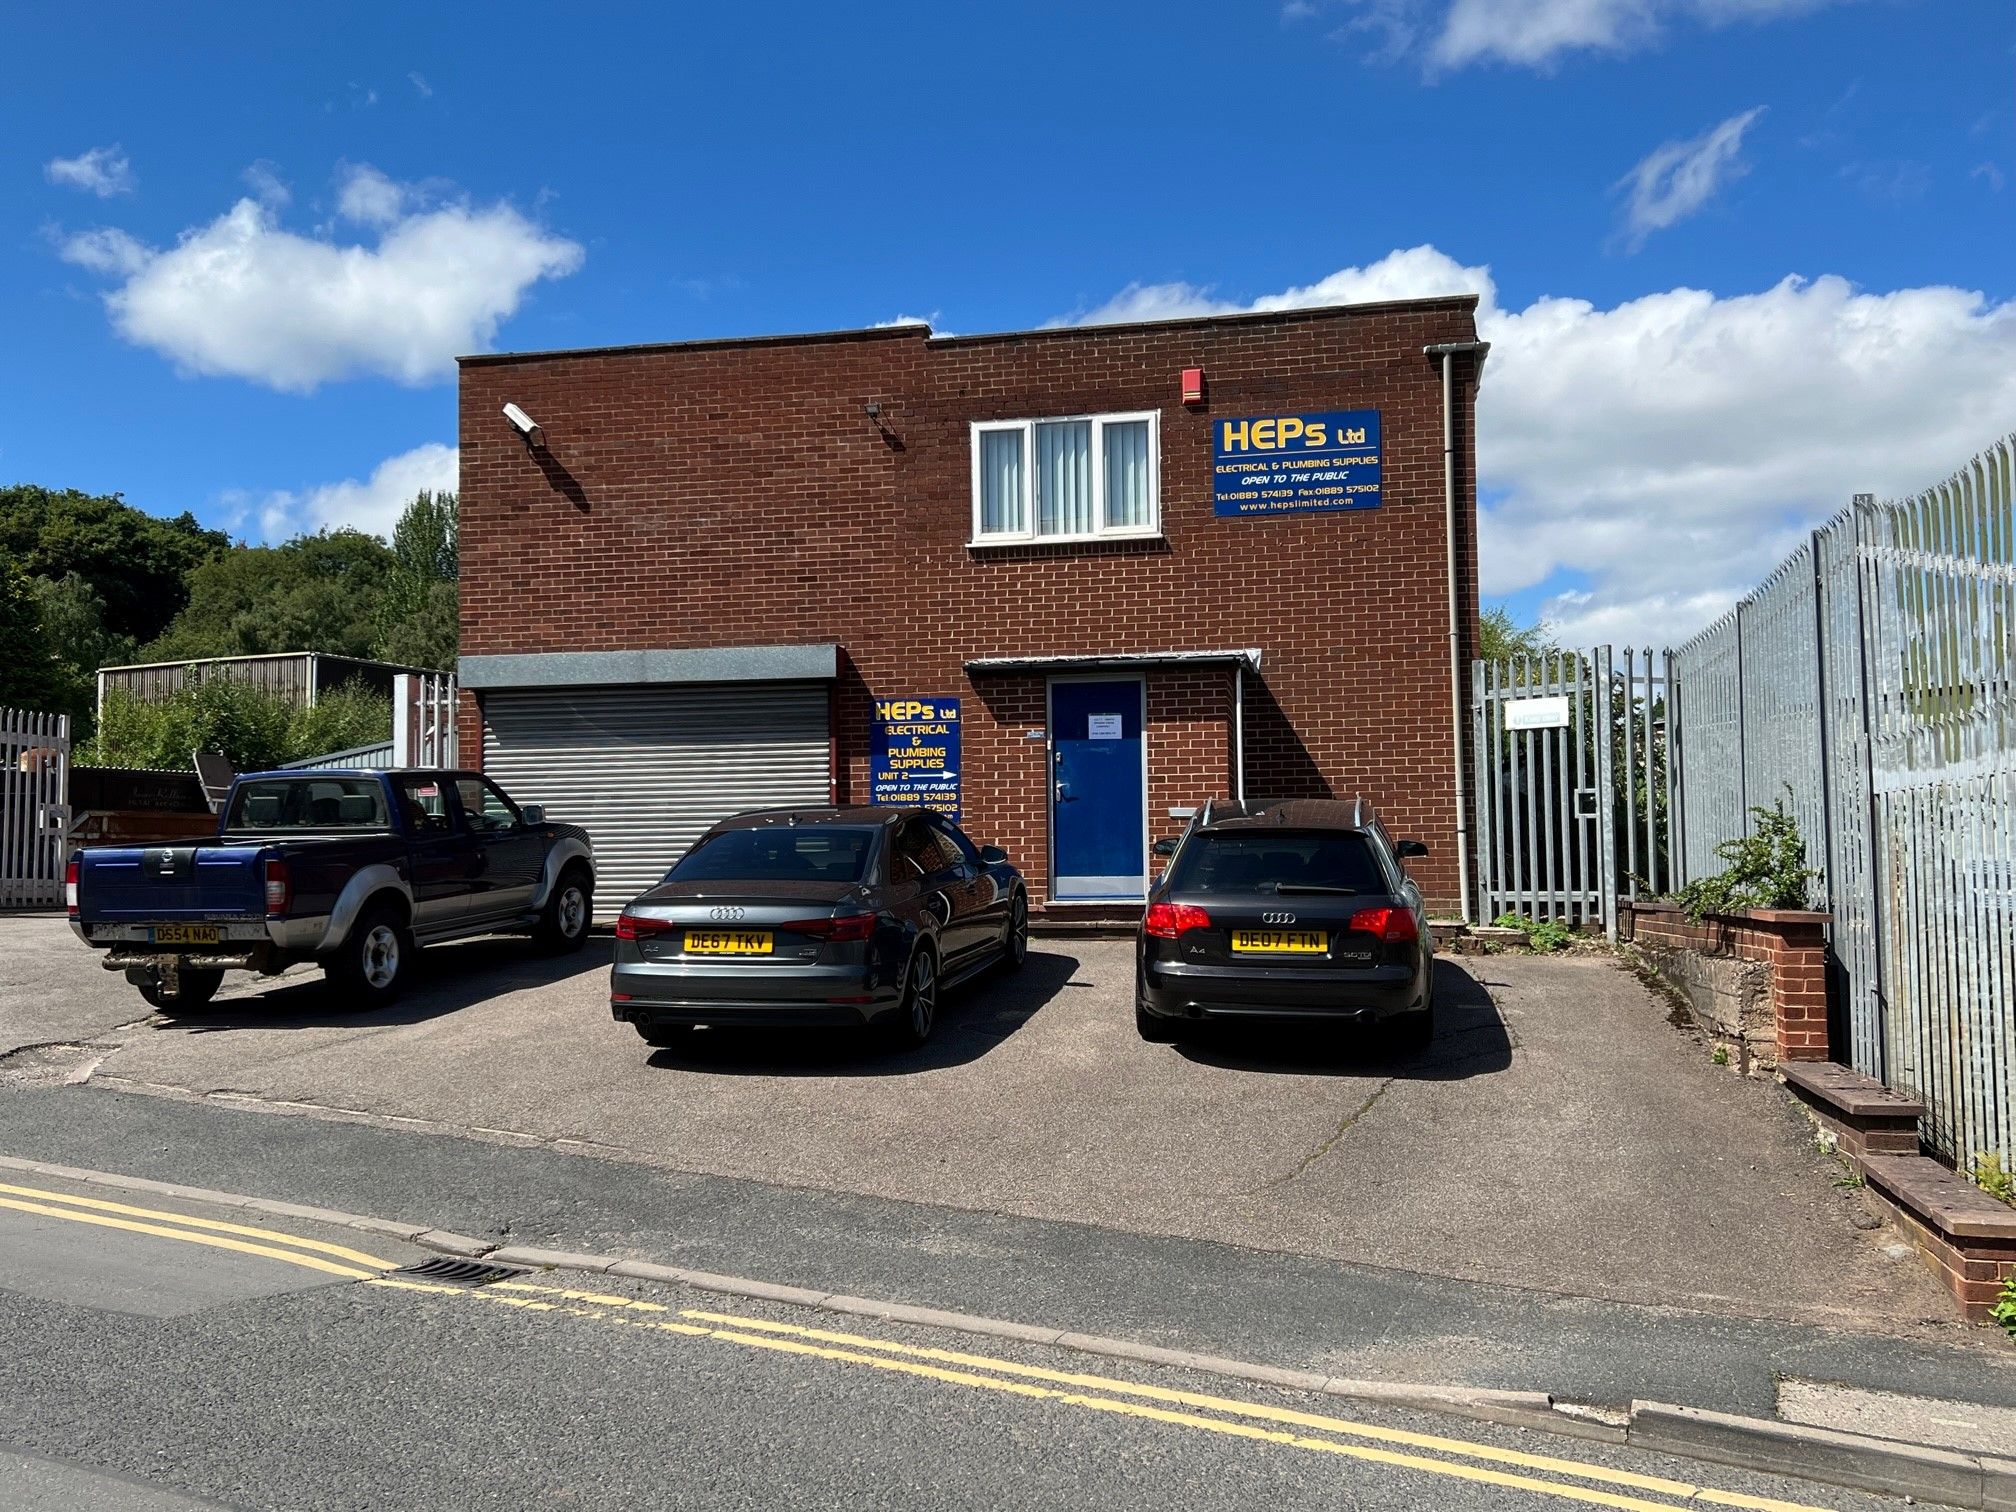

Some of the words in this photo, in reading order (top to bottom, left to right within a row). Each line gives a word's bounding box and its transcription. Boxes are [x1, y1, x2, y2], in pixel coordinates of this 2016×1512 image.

[1223, 417, 1327, 452] HEPs
[1337, 427, 1366, 445] Ltd
[1215, 462, 1269, 474] ELECTRICAL
[1271, 461, 1279, 470] &
[1282, 458, 1330, 470] PLUMBING
[1332, 455, 1379, 466] SUPPLIES
[1241, 475, 1270, 486] OPEN
[1273, 474, 1287, 484] TO
[1290, 473, 1310, 483] THE
[1312, 470, 1350, 482] PUBLIC
[1261, 489, 1294, 498] 574139
[1346, 484, 1379, 493] 575102
[1239, 497, 1354, 511] www.hepslimited.com
[875, 701, 935, 721] HEPs
[939, 708, 957, 719] Ltd
[885, 724, 950, 735] ELECTRICAL
[911, 736, 922, 746] &
[888, 747, 946, 758] PLUMBING
[889, 758, 945, 769] SUPPLIES
[878, 771, 899, 780] UNIT
[901, 771, 909, 780] 2
[875, 784, 898, 792] OPEN
[913, 783, 929, 791] THE
[929, 783, 958, 791] PUBLIC
[923, 792, 957, 801] 574139
[157, 928, 189, 941] DS54
[1239, 931, 1282, 948] DE07
[1286, 931, 1321, 949] FTN
[691, 933, 731, 950] DE67
[736, 933, 766, 950] TKV
[1190, 945, 1206, 955] A4
